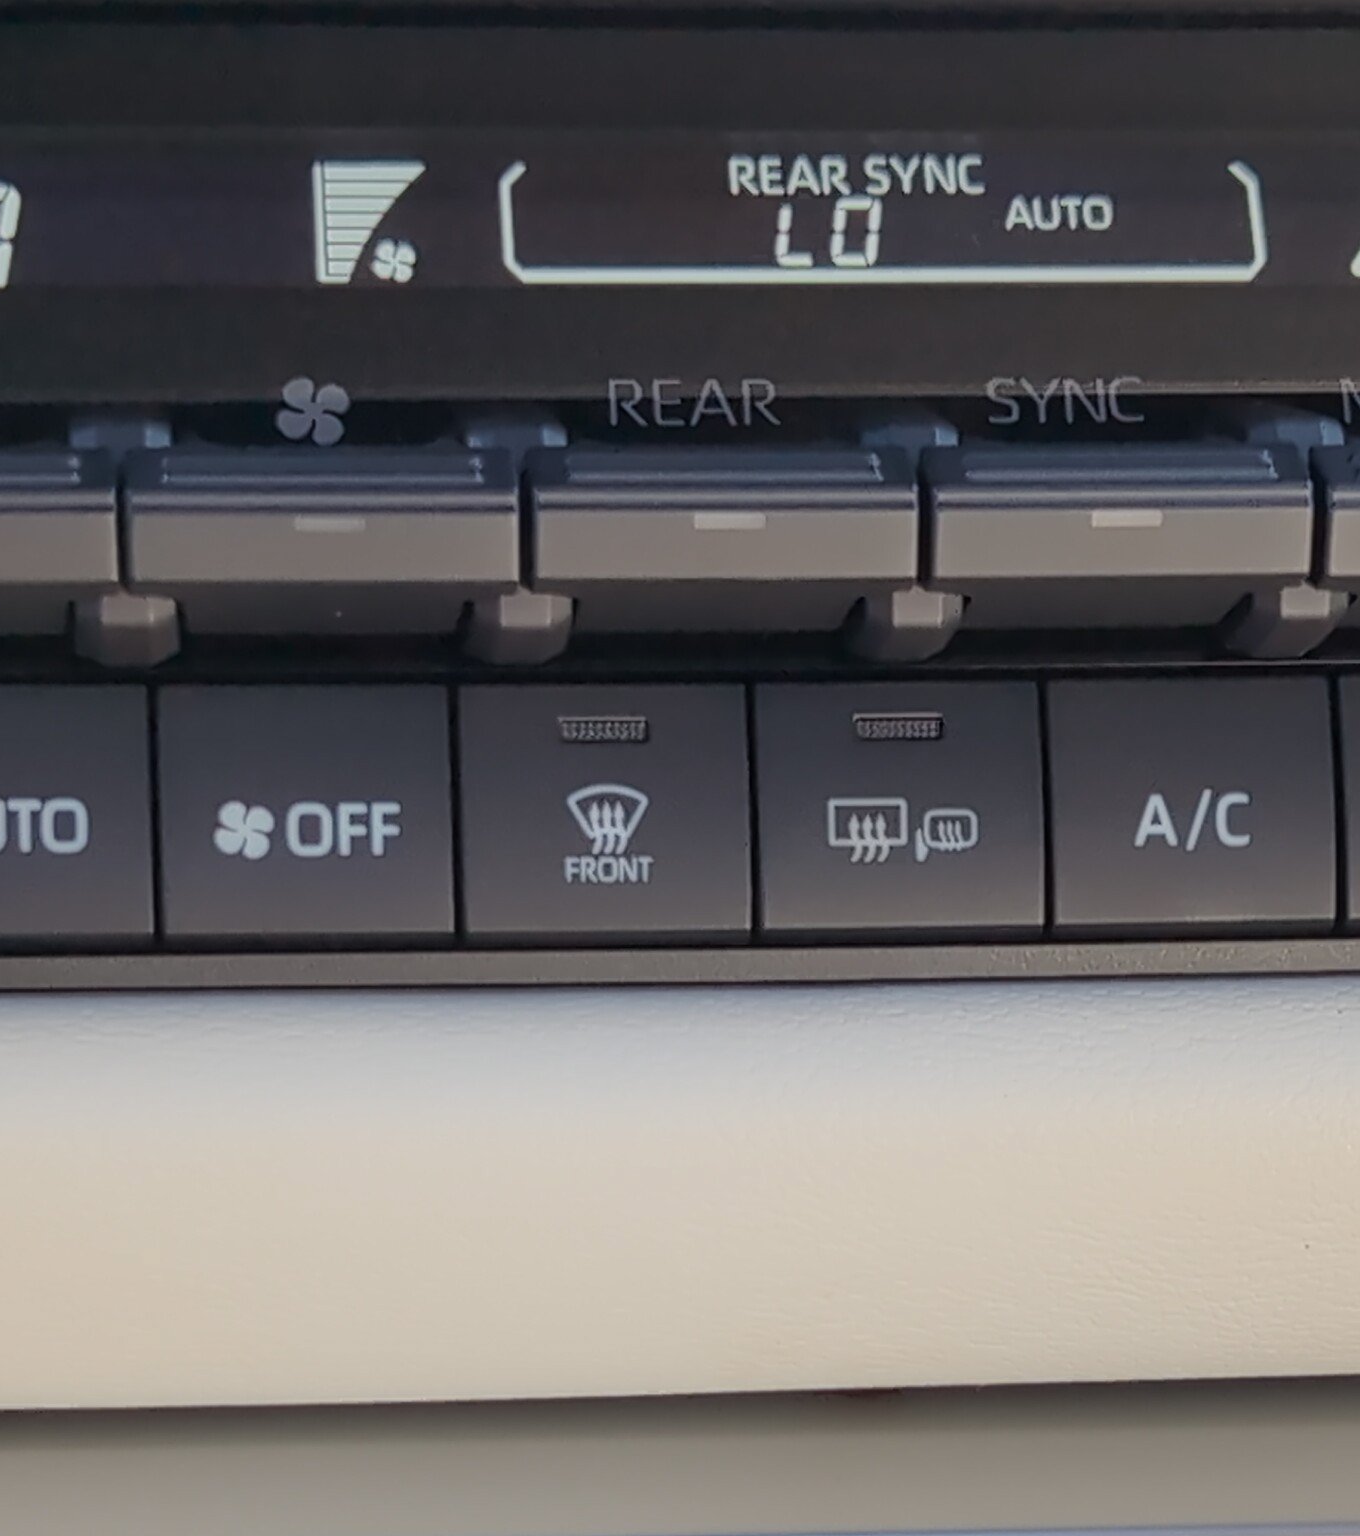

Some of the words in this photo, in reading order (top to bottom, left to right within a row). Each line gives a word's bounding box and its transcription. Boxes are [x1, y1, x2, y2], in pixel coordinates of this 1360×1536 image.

[727, 153, 851, 196] REAR
[863, 153, 985, 196] SYNC
[1004, 195, 1114, 232] AUTO
[607, 377, 782, 427] REAR
[985, 376, 1145, 425] SYNC
[285, 801, 402, 858] OFF
[1133, 788, 1252, 851] A/C
[564, 855, 654, 884] FRONT
